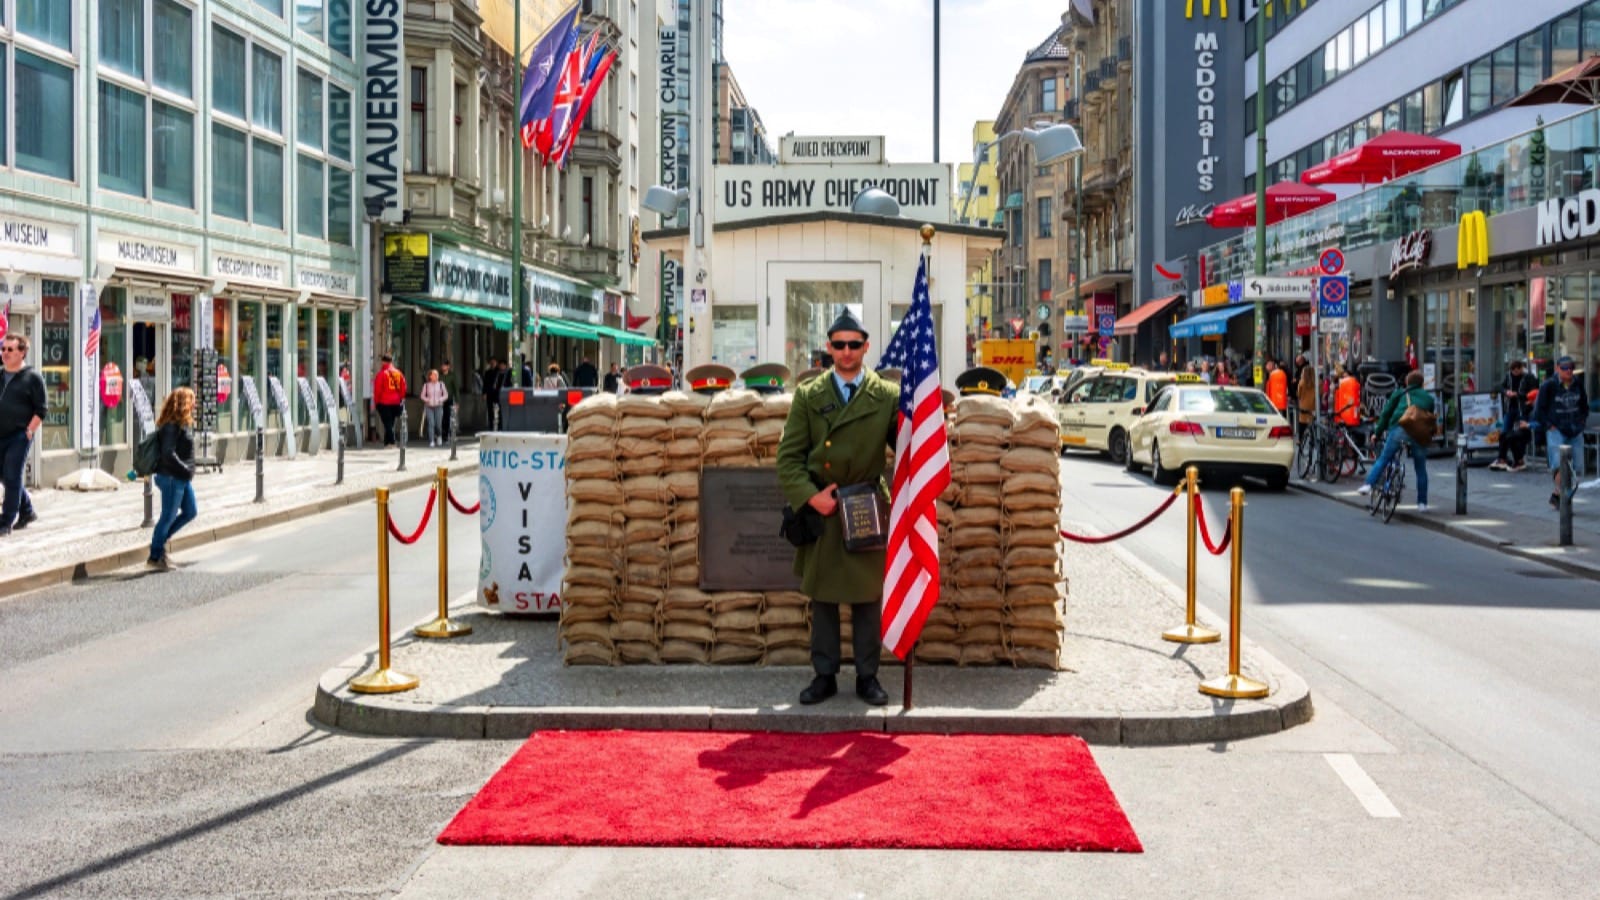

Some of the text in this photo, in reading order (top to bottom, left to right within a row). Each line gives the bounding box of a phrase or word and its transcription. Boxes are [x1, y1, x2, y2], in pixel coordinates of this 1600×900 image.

[661, 31, 675, 103] CHARLIE
[1194, 32, 1219, 191] McDonald's
[792, 140, 871, 157] ALLIED CHECKPOINT
[762, 179, 816, 207] ARMY
[4, 221, 48, 247] MUSEUM
[118, 240, 177, 265] MAUERMUSEUM
[217, 257, 279, 281] CHECKPOINT CHARLIE
[1322, 303, 1345, 314] TAXI
[992, 356, 1025, 365] DHL
[517, 481, 532, 582] VISA
